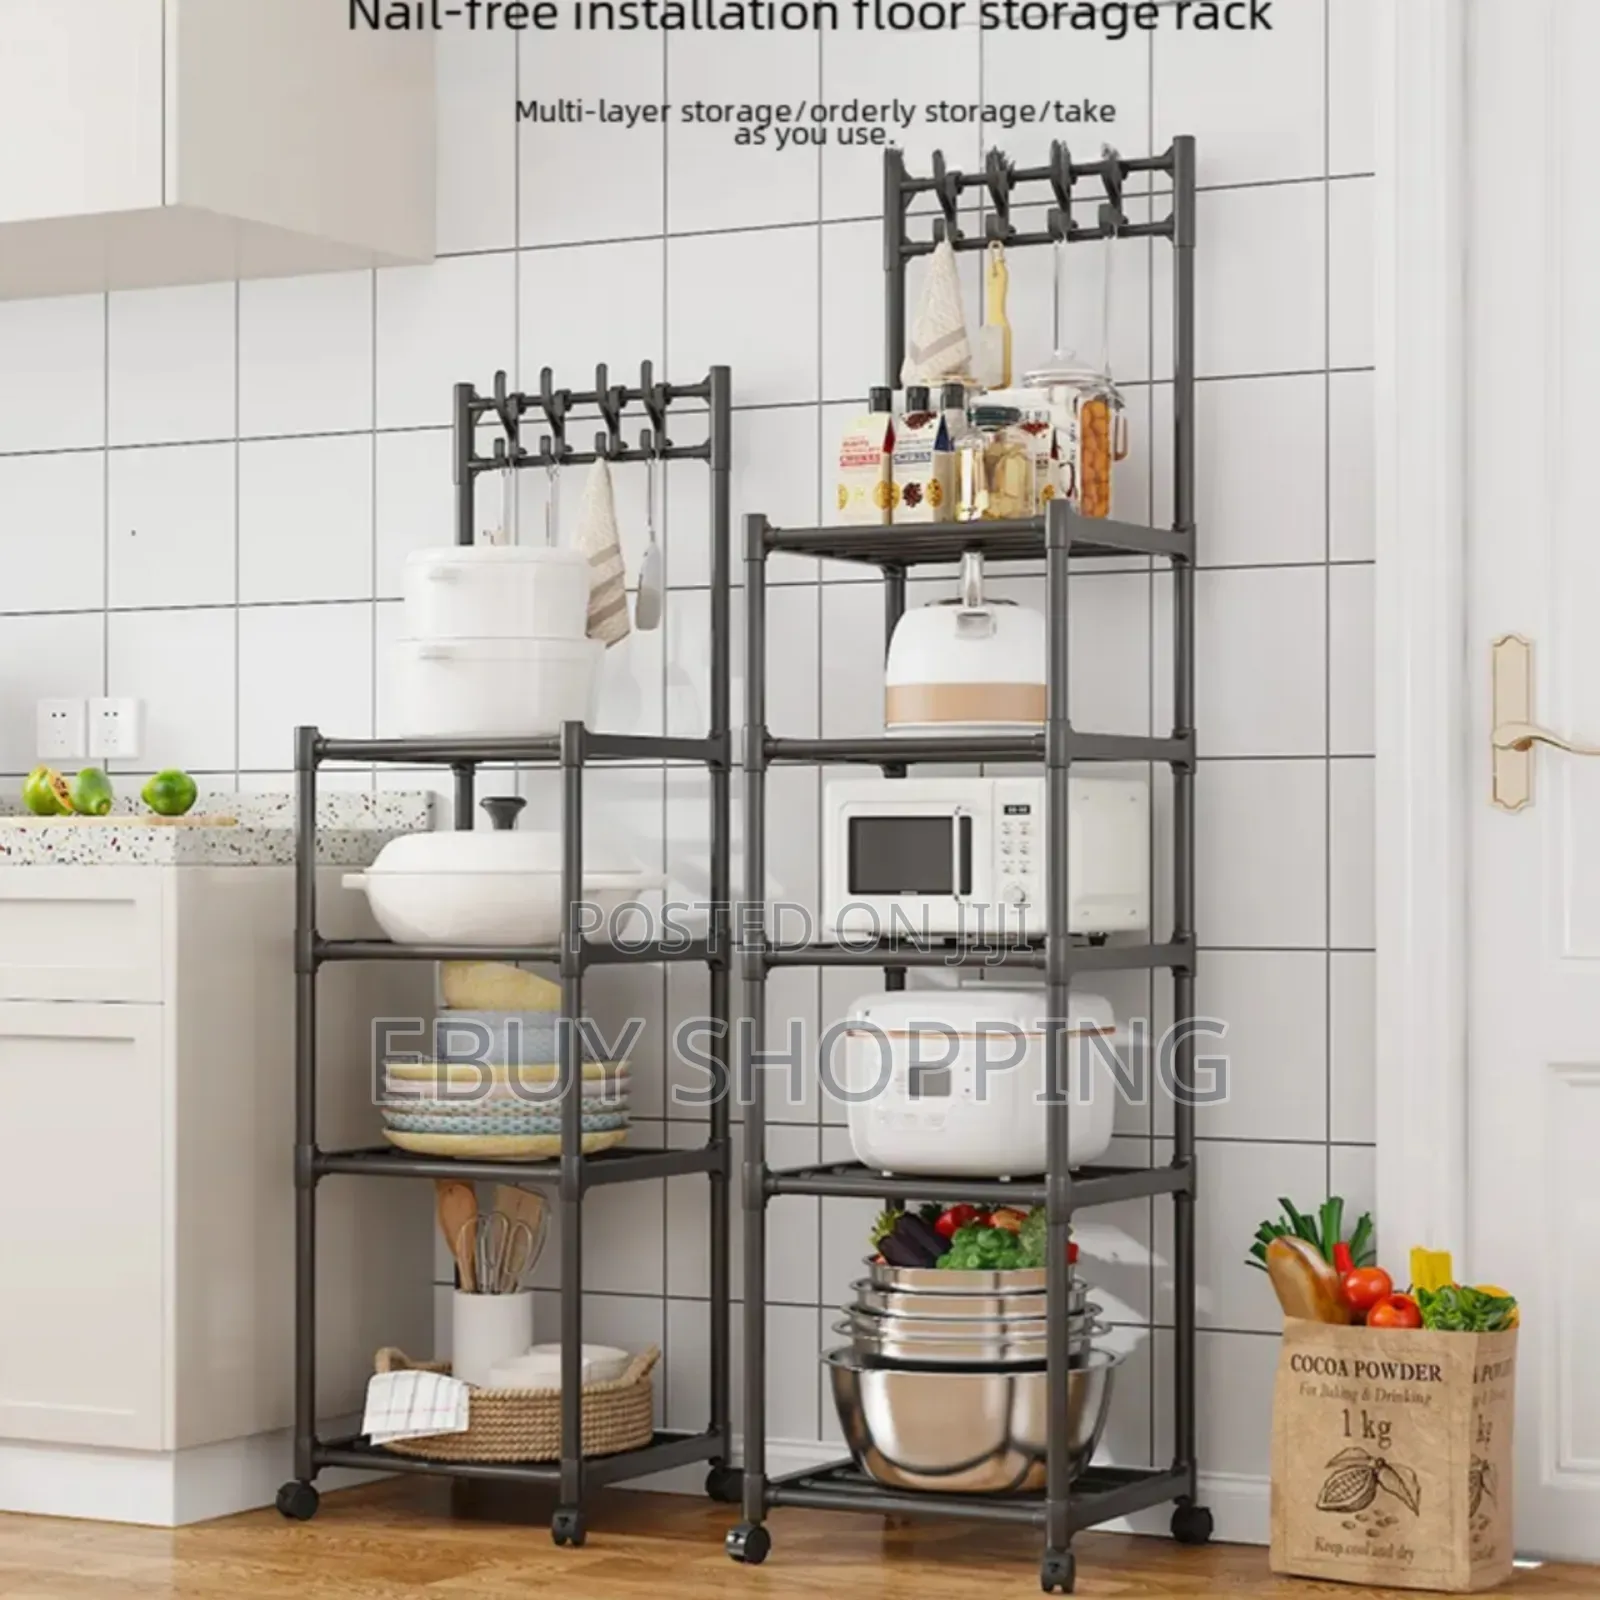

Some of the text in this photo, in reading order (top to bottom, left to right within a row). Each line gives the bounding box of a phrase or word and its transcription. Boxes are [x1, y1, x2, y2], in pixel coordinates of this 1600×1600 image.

[1290, 1354, 1443, 1382] COCOA POWDER
[1299, 1382, 1317, 1397] For
[1319, 1384, 1358, 1404] Baking
[1374, 1388, 1432, 1405] Drinking
[1342, 1408, 1392, 1450] 1 kg
[1314, 1536, 1343, 1557] Keep
